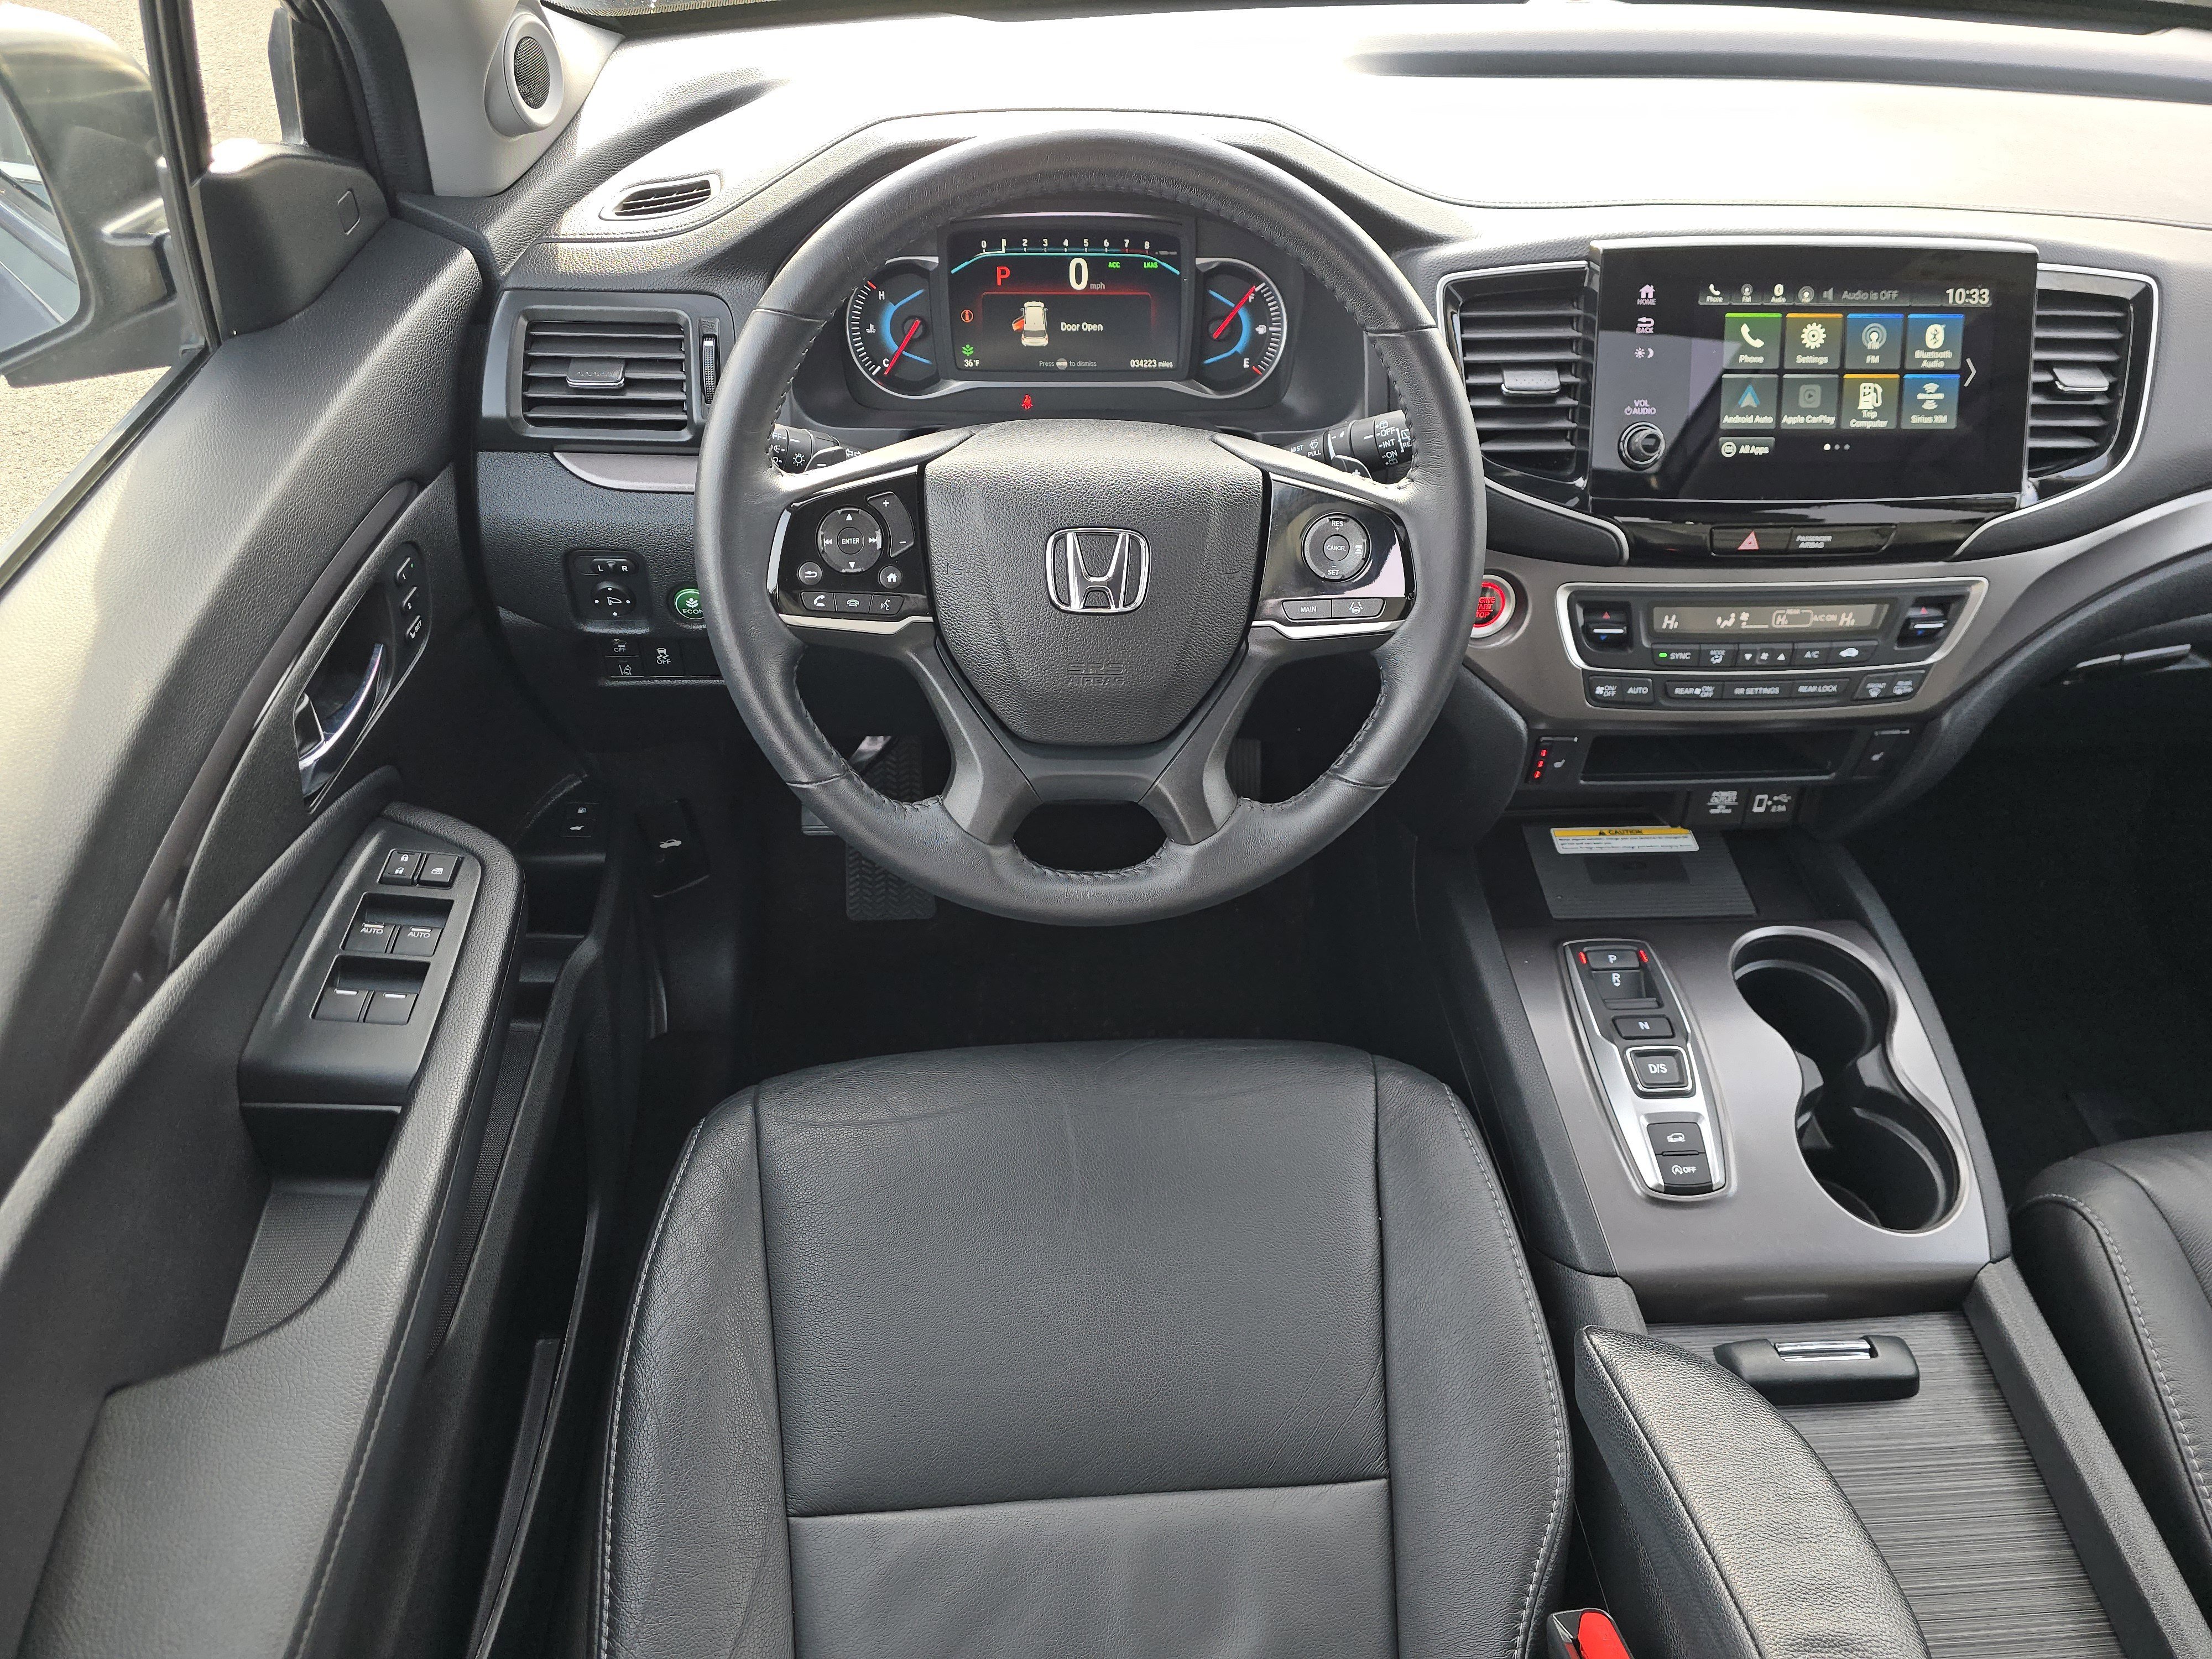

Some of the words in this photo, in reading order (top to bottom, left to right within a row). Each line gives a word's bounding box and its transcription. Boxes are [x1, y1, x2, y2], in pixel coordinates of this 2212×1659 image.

[1104, 239, 1109, 247] 6
[997, 266, 1010, 286] P
[1069, 257, 1088, 290] 0
[1090, 281, 1105, 290] mph
[879, 291, 885, 300] H
[1249, 293, 1255, 302] F
[1841, 290, 1869, 300] Audio
[1870, 290, 1879, 300] is
[1880, 290, 1899, 300] OFF
[1945, 288, 1990, 304] 10:33
[1061, 322, 1080, 331] Door
[1082, 322, 1103, 332] Open
[1739, 354, 1764, 363] Phone
[1914, 350, 1953, 358] Bluetooth
[883, 358, 889, 367] C
[1243, 358, 1250, 368] E
[1796, 354, 1829, 365] Settings
[1866, 355, 1880, 363] FM
[1921, 359, 1944, 368] Audio
[1861, 410, 1877, 419] Trip
[1722, 415, 1754, 424] Android
[1754, 415, 1773, 424] Auto
[1781, 415, 1805, 425] Apple
[1806, 415, 1836, 425] CarPlay
[1849, 419, 1888, 429] Computer
[772, 432, 782, 440] FF
[1380, 427, 1395, 437] OFF
[1383, 439, 1395, 448] INT
[1291, 444, 1304, 453] MIST
[1739, 445, 1750, 453] All
[1750, 445, 1769, 455] Apps
[1385, 450, 1398, 459] ON
[1067, 663, 1123, 675] SRS
[1608, 954, 1617, 963] P
[1611, 973, 1621, 983] R
[1640, 1021, 1650, 1030] N
[1648, 1063, 1667, 1074] D/S
